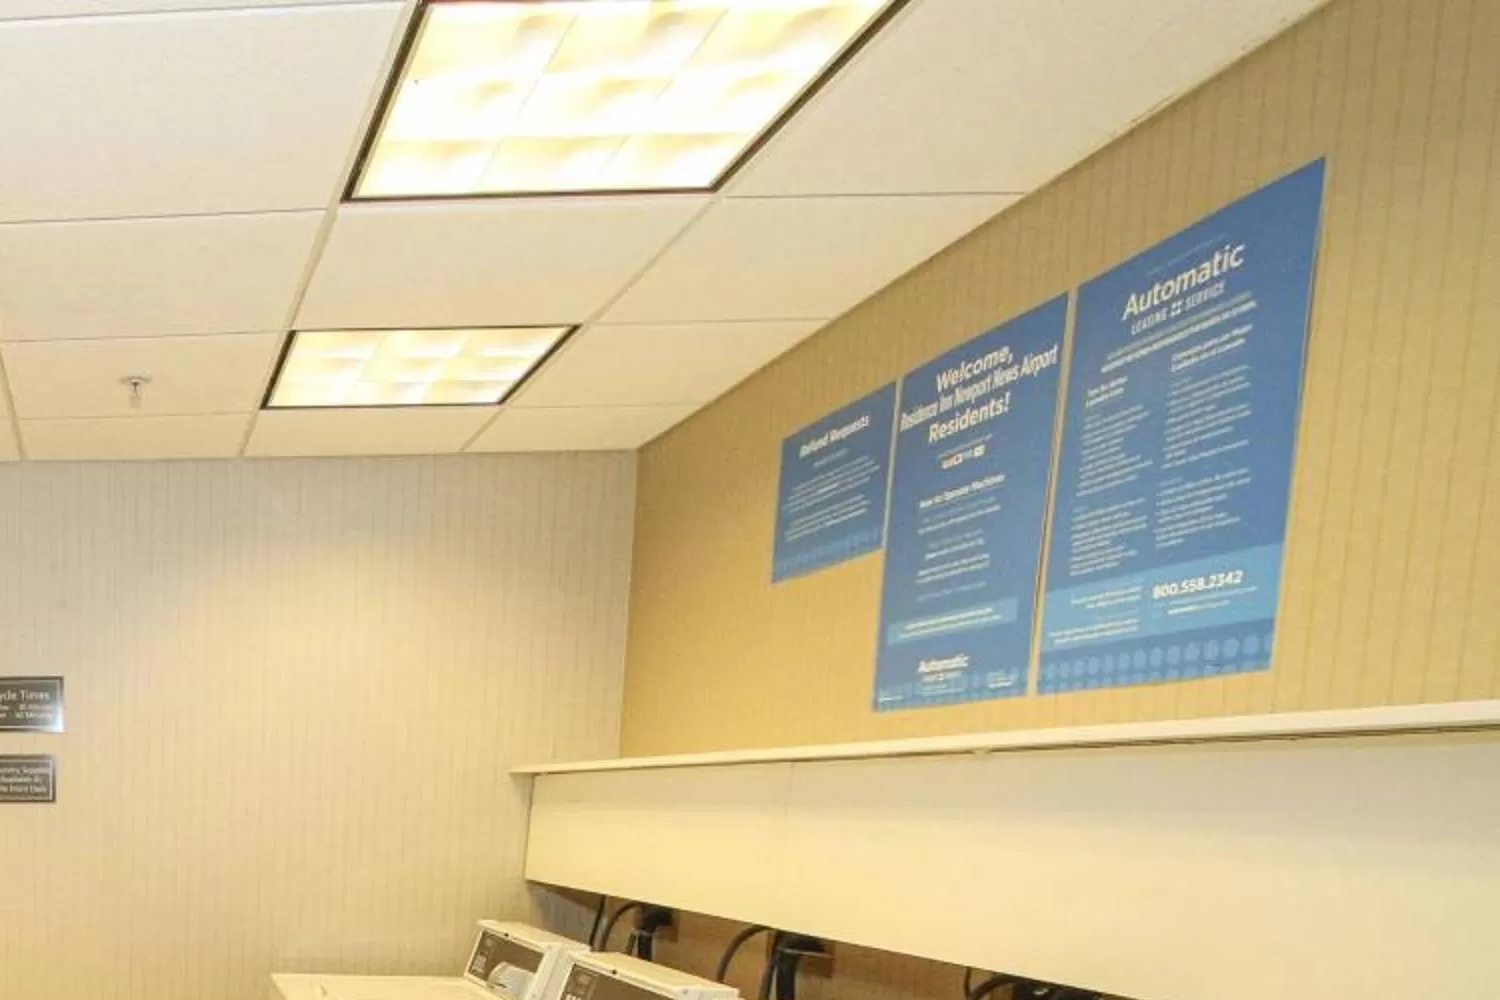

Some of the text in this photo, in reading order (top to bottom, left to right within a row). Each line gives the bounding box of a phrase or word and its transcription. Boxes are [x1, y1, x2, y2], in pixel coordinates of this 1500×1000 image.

[1122, 244, 1246, 321] Automatic
[936, 345, 1013, 393] Welcome,
[1020, 343, 1059, 378] Airport
[928, 391, 1012, 444] Residents!
[20, 689, 50, 701] Times
